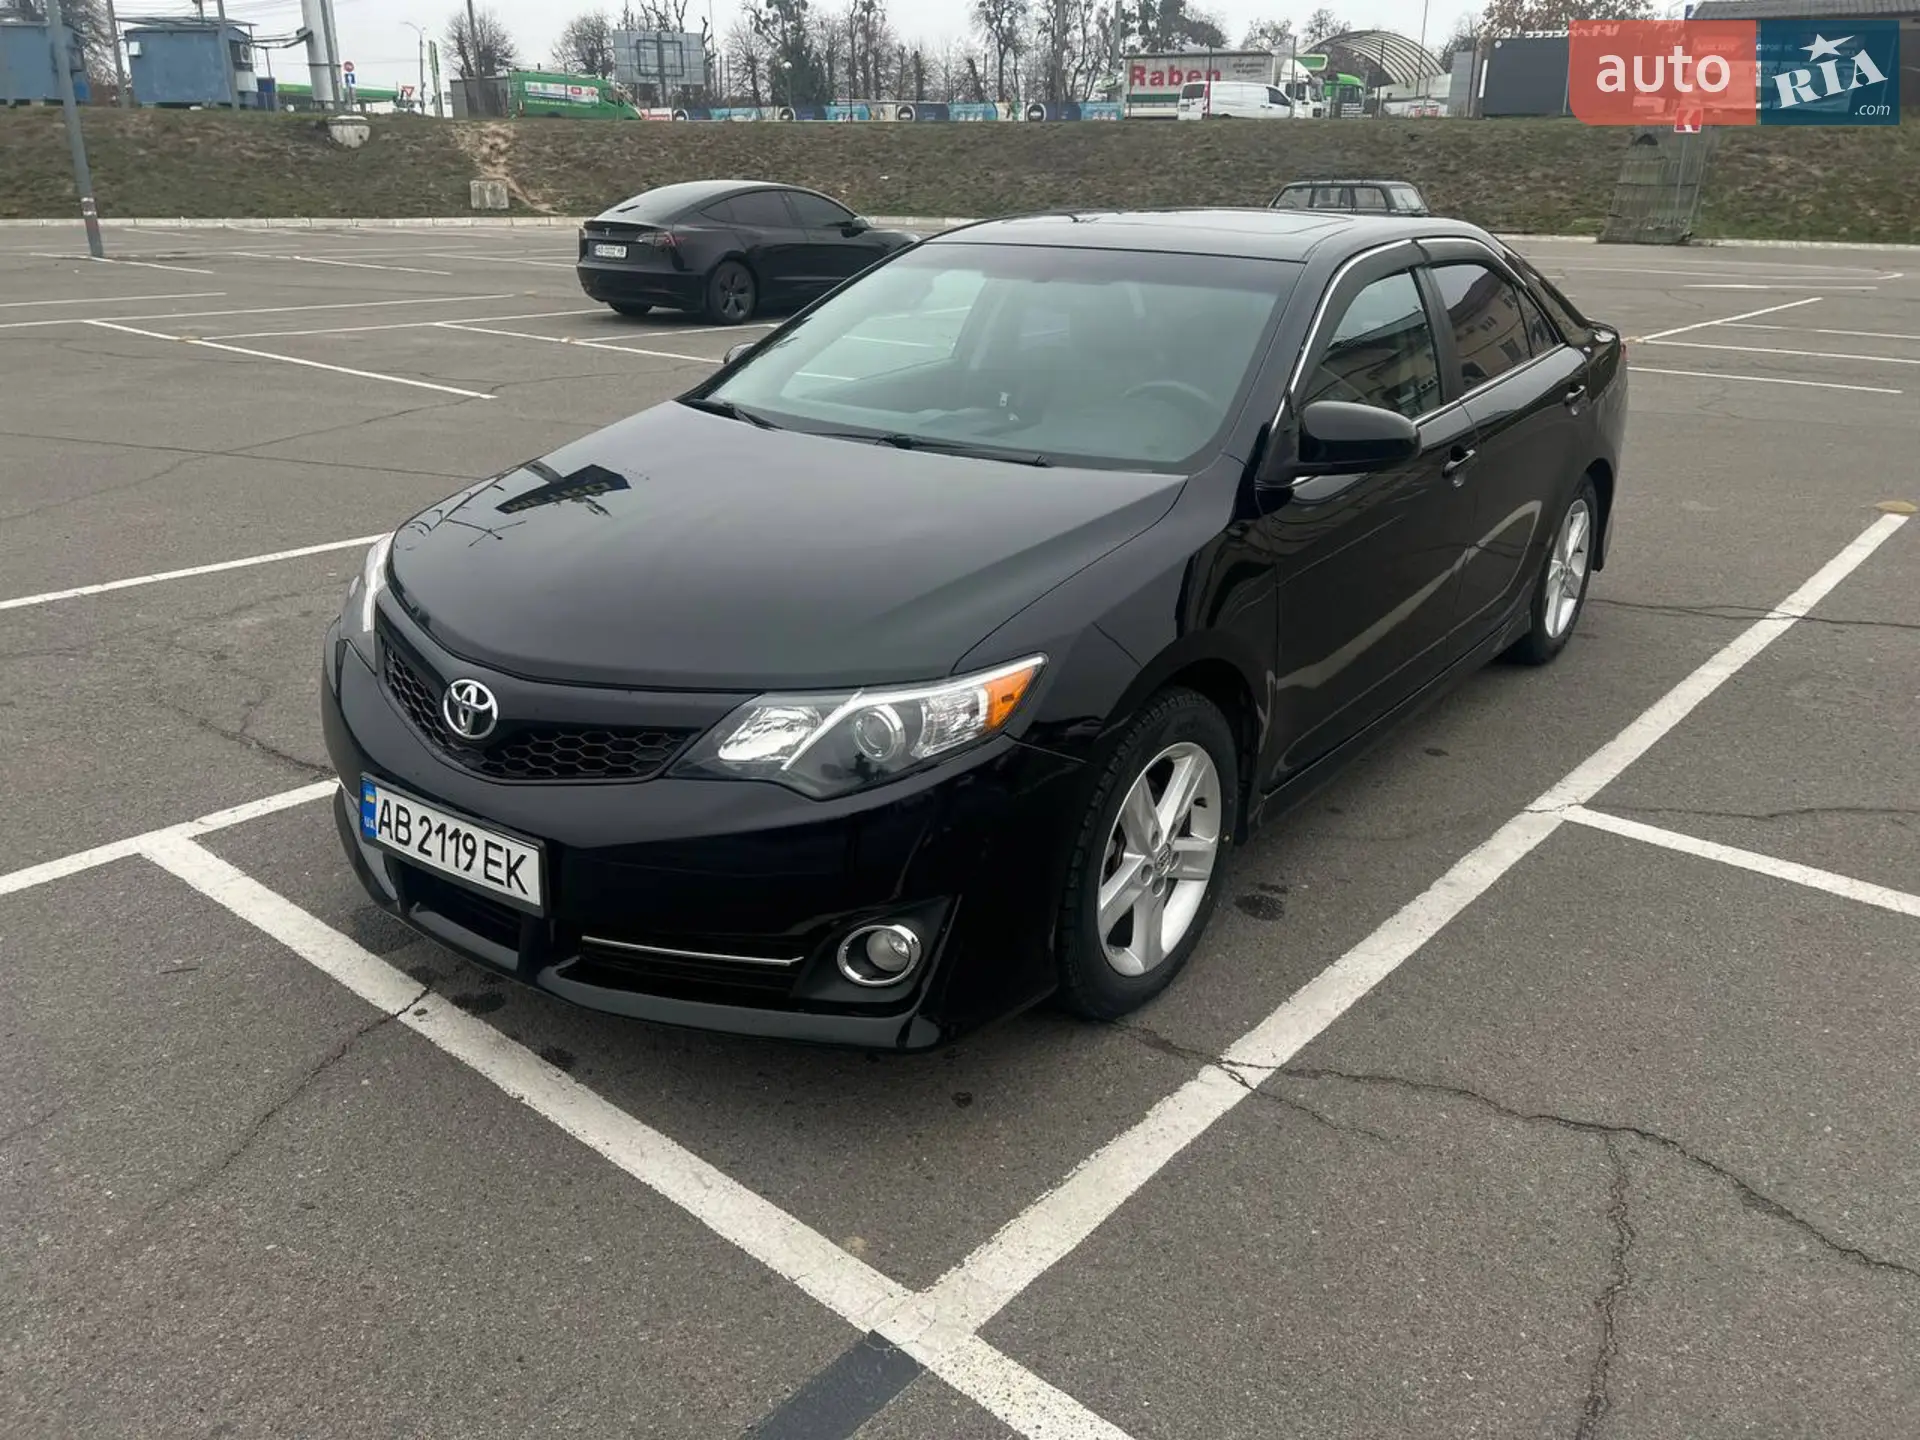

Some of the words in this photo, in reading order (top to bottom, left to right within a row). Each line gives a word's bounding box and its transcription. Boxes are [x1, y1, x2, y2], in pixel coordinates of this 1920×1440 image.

[1130, 64, 1221, 87] Raben
[378, 799, 412, 846] AB
[417, 816, 477, 871] 2119
[484, 839, 528, 895] EK
